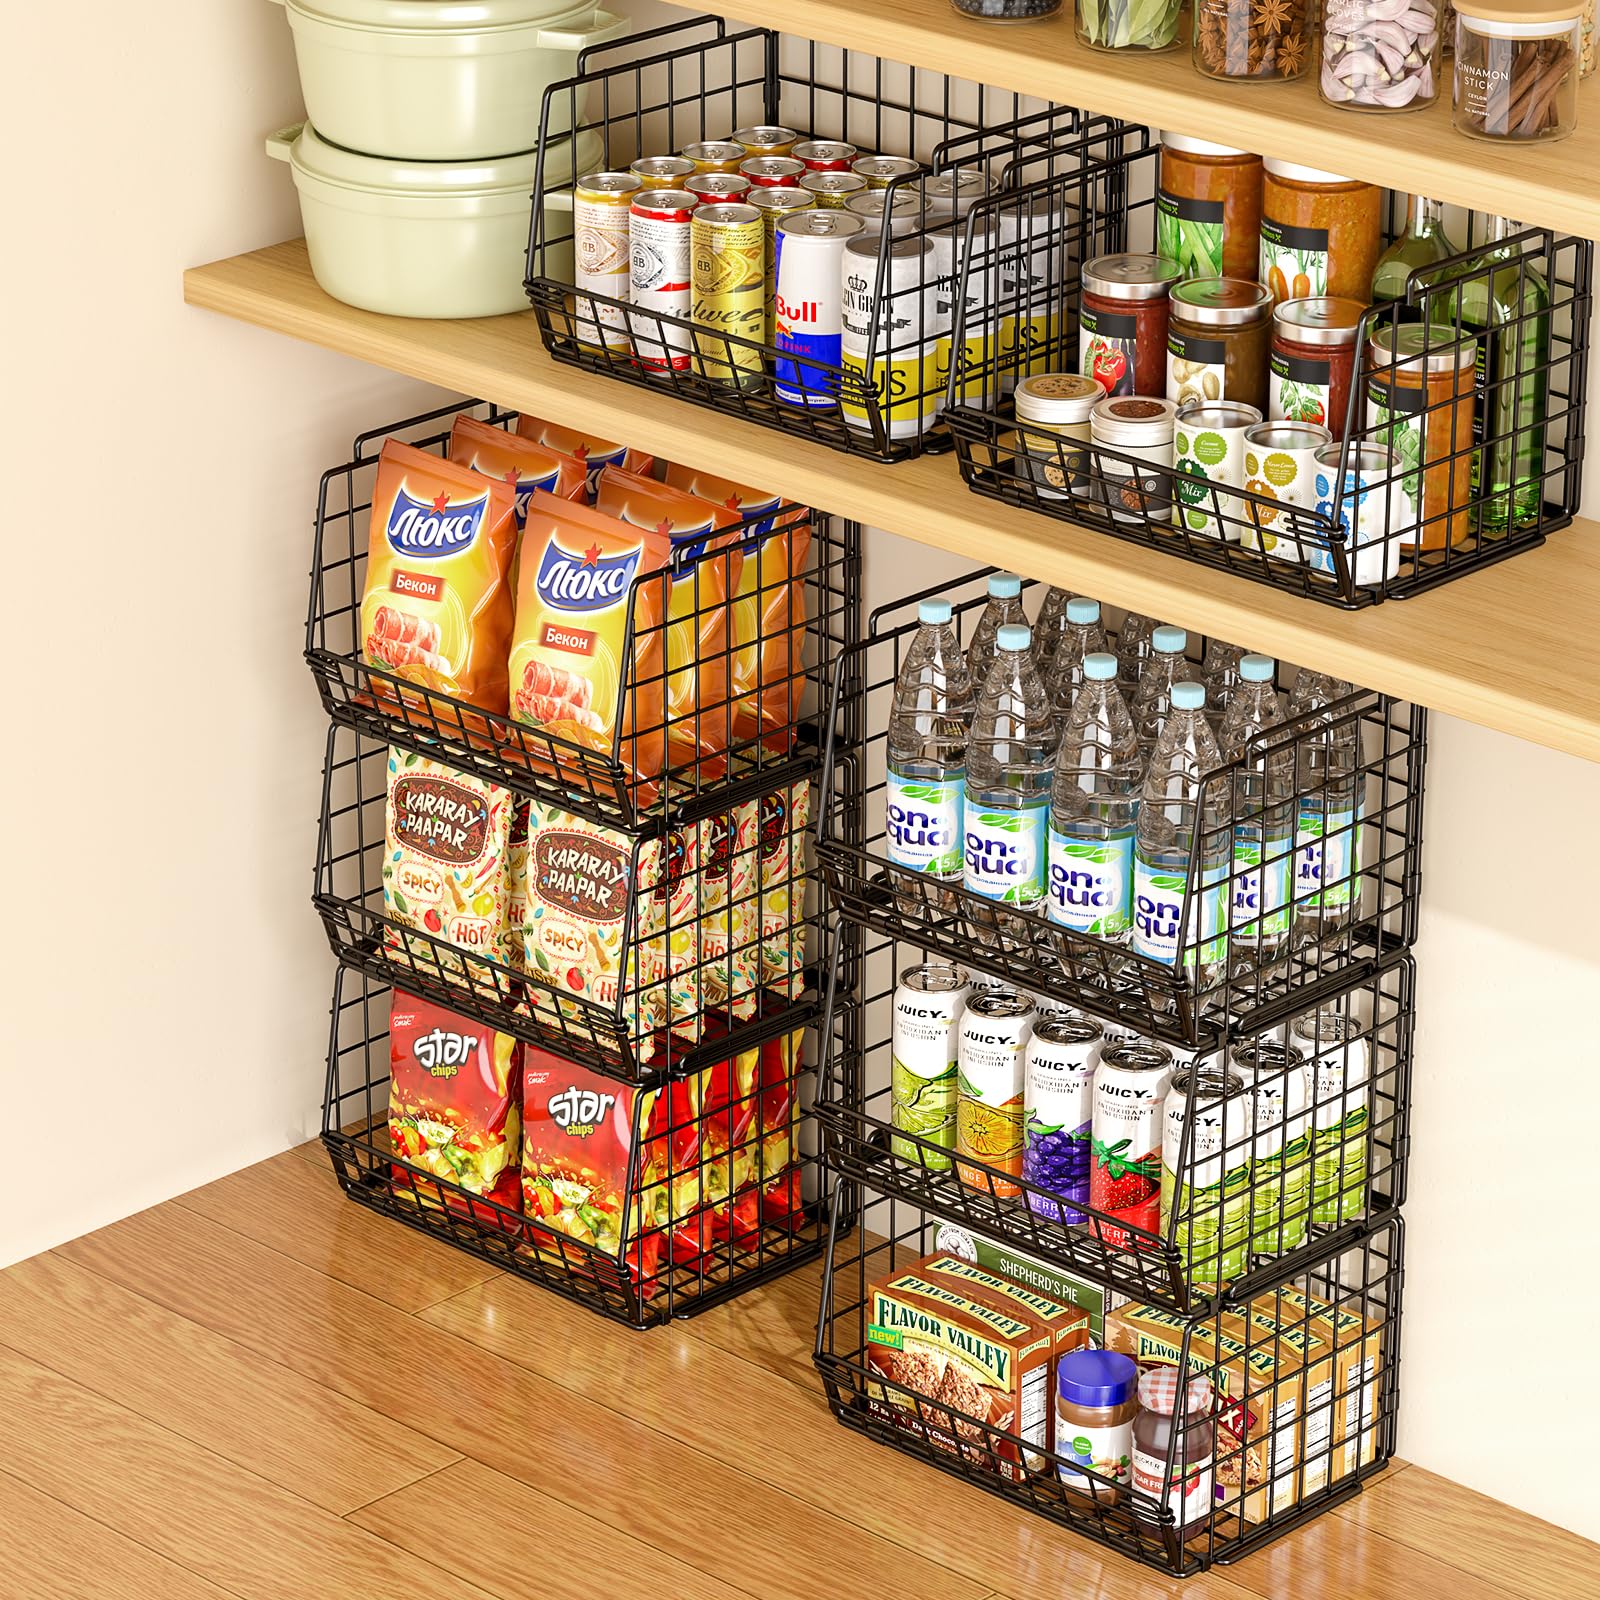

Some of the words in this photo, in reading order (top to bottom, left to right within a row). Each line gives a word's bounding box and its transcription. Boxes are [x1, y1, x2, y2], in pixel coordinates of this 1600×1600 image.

[1457, 61, 1509, 81] CINNAMON
[1464, 76, 1494, 91] STICK
[776, 294, 816, 322] Bull
[396, 573, 437, 595] Бекон
[545, 627, 588, 649] Бекон
[406, 791, 480, 828] KARARAY
[406, 814, 468, 851] PAAPAR
[548, 847, 625, 885] KARARAY
[403, 871, 440, 894] SPICY
[548, 870, 612, 908] PAAPAR
[456, 922, 487, 945] HOT
[1135, 912, 1182, 938] qu
[545, 928, 583, 952] SPICY
[413, 1028, 478, 1067] star
[431, 1063, 457, 1079] chips
[548, 1086, 615, 1127] star
[566, 1122, 593, 1138] chips
[934, 1259, 1003, 1287] FLAVOR
[1007, 1286, 1063, 1317] VALLEY
[1000, 1258, 1060, 1295] SHEPHERD'S
[1062, 1284, 1078, 1303] PIE
[897, 1277, 964, 1306] FLAVOR
[968, 1304, 1026, 1336] VALLEY
[869, 1327, 900, 1346] new!
[878, 1297, 941, 1337] FLAVOR
[947, 1326, 1008, 1382] VALLEY
[869, 1401, 879, 1411] 12
[911, 1421, 933, 1436] Dak
